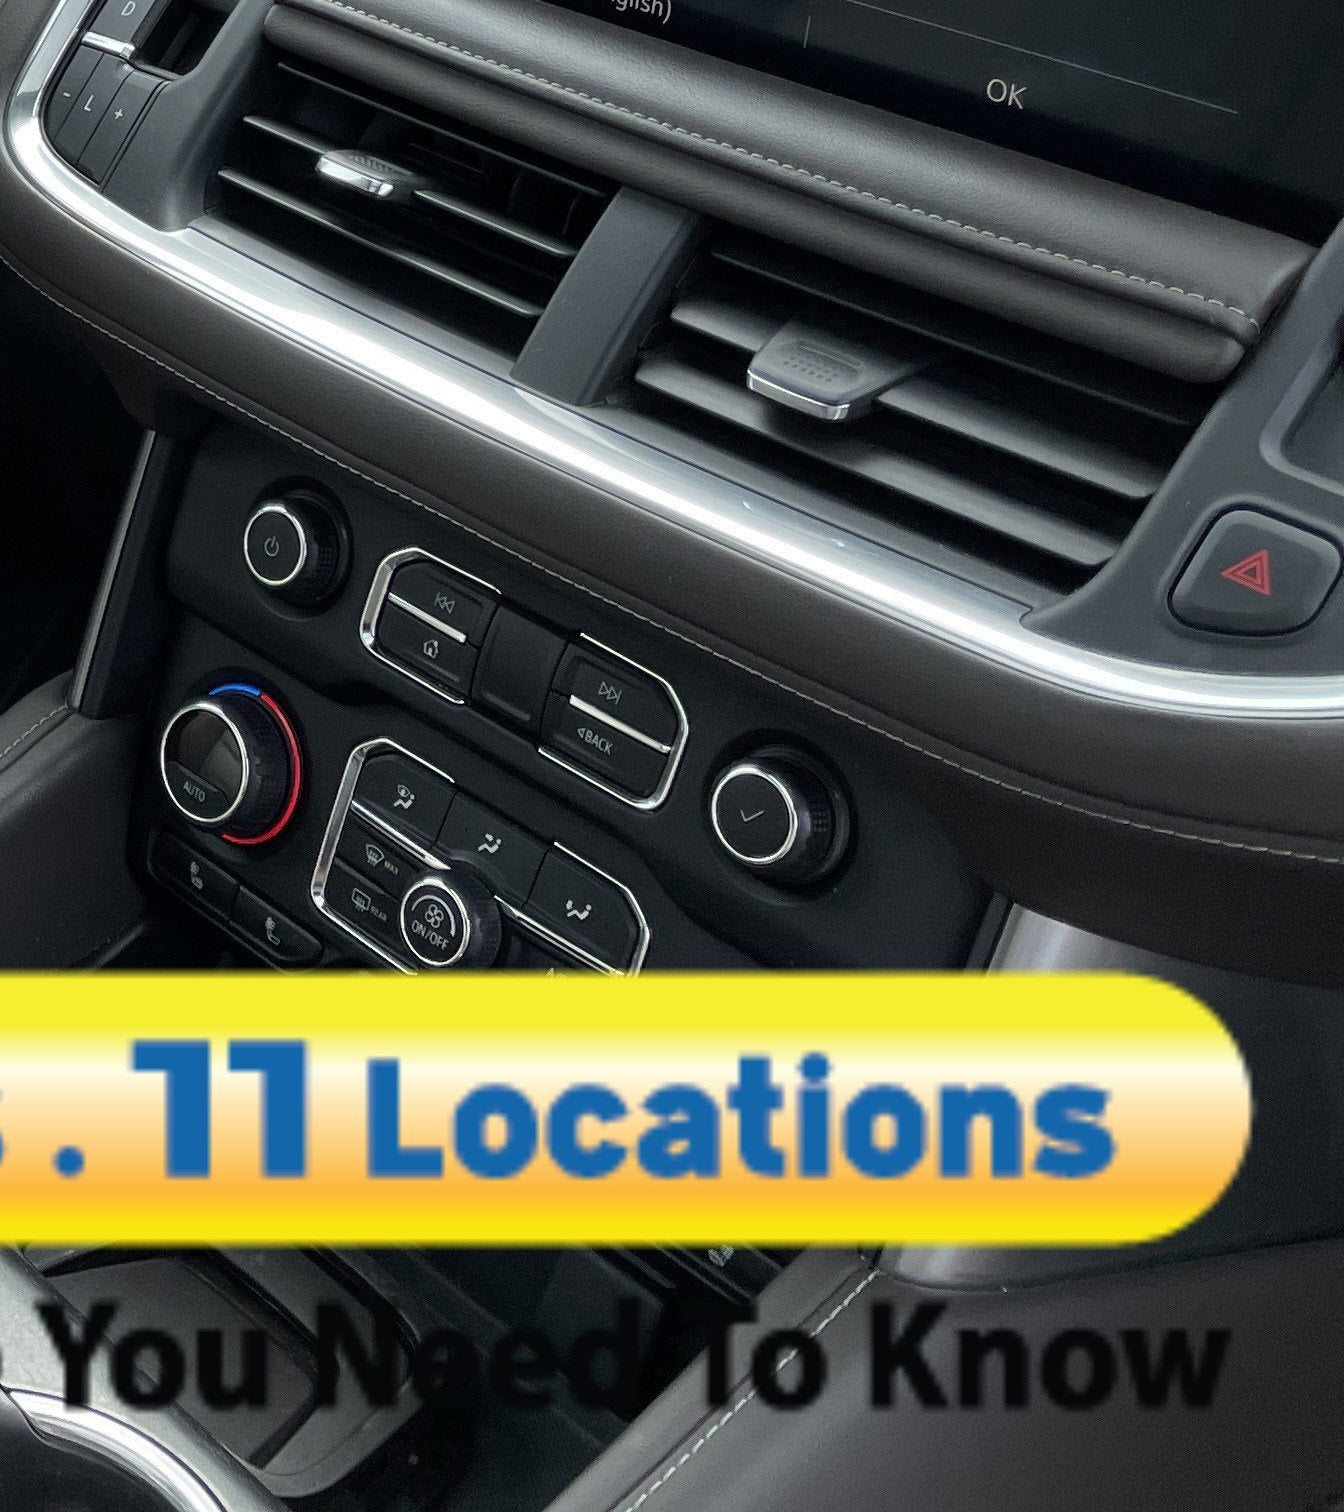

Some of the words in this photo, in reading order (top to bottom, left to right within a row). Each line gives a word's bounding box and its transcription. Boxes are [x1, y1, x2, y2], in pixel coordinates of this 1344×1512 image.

[121, 1, 137, 16] D
[83, 94, 95, 112] L
[986, 78, 1028, 110] OK
[584, 729, 614, 756] BACK
[182, 780, 206, 803] AUTO
[410, 919, 450, 951] ON/OFF
